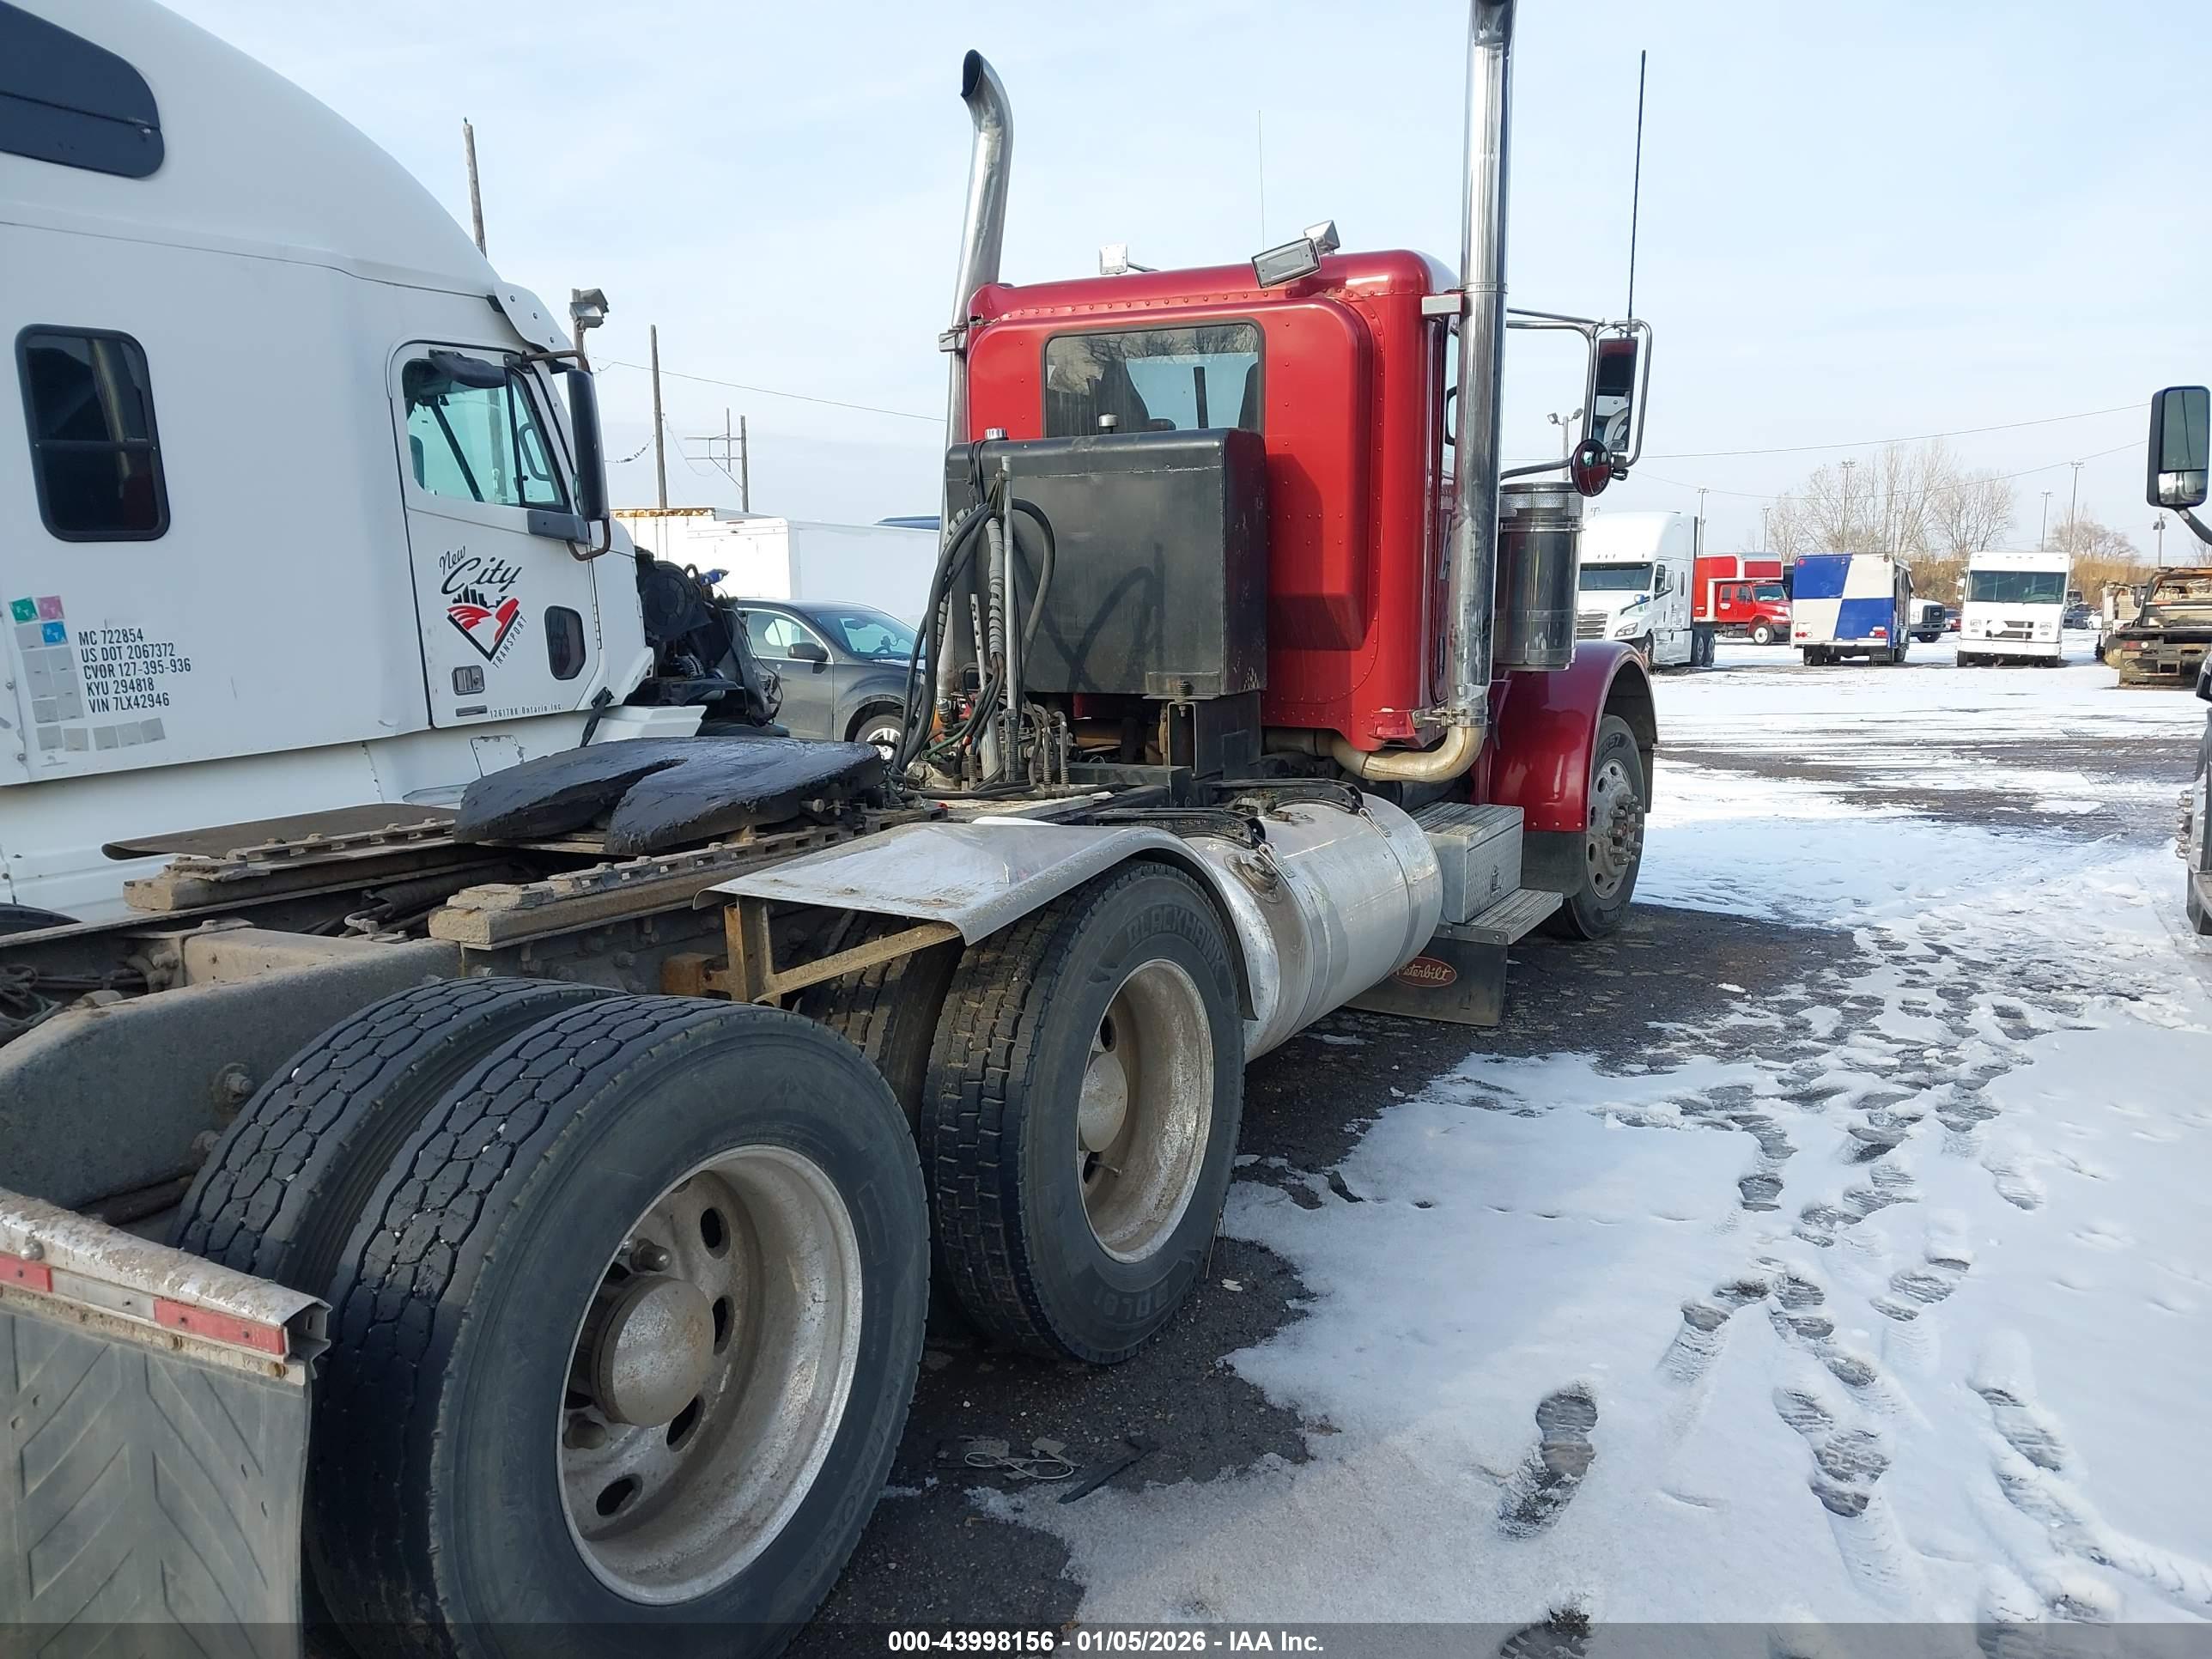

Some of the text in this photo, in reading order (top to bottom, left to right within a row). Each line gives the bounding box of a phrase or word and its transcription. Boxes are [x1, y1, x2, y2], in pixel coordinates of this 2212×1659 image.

[439, 545, 466, 576] New
[441, 556, 522, 595] City
[78, 630, 97, 646] MC
[100, 628, 143, 644] 722854
[492, 615, 528, 669] TRANSPORT
[81, 642, 175, 663] US DOT 2067372
[83, 658, 191, 680] CVOR 127-395-936
[87, 677, 155, 696] KYU 294818
[88, 692, 170, 714] VIN 7LX42946
[521, 704, 548, 714] Ontario
